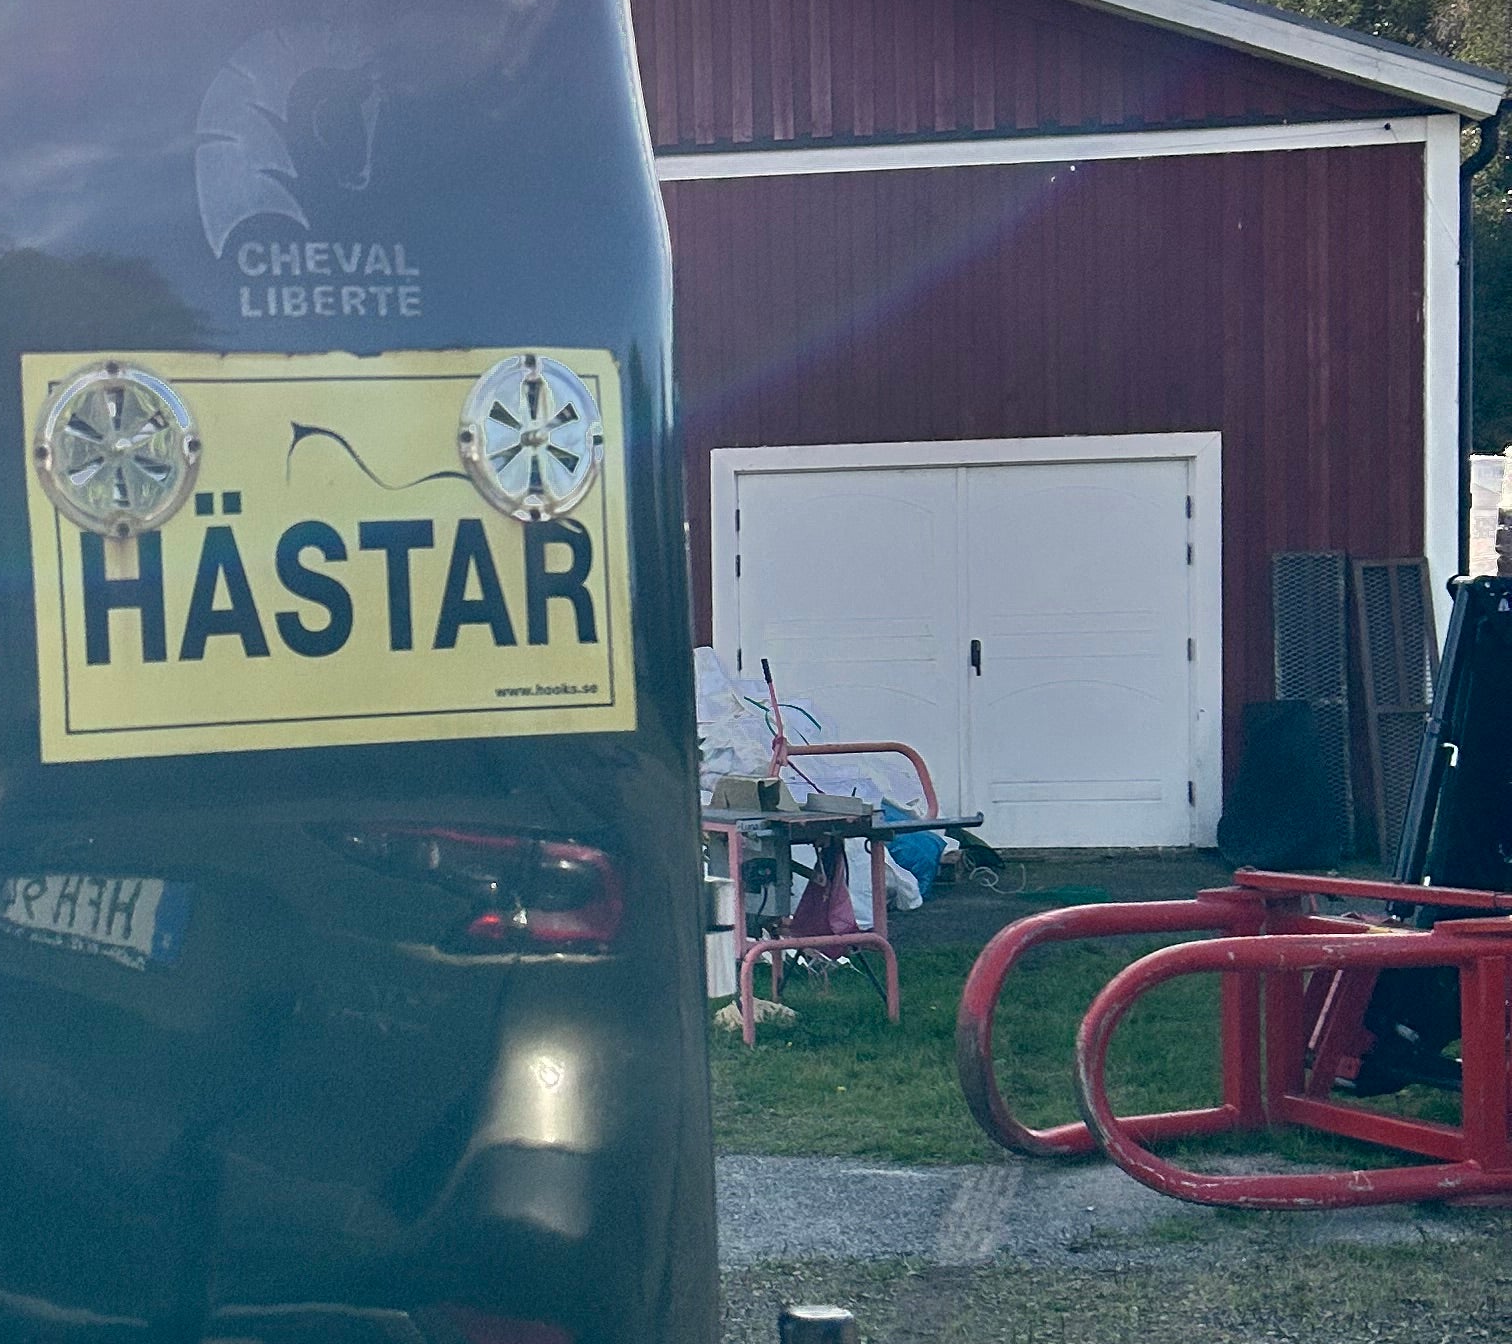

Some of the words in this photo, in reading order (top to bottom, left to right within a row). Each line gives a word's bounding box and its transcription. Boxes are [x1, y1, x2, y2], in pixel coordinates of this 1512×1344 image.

[237, 241, 420, 277] CHEVAL
[79, 490, 599, 666] HÄSTAR
[494, 683, 598, 697] www.hooks.se
